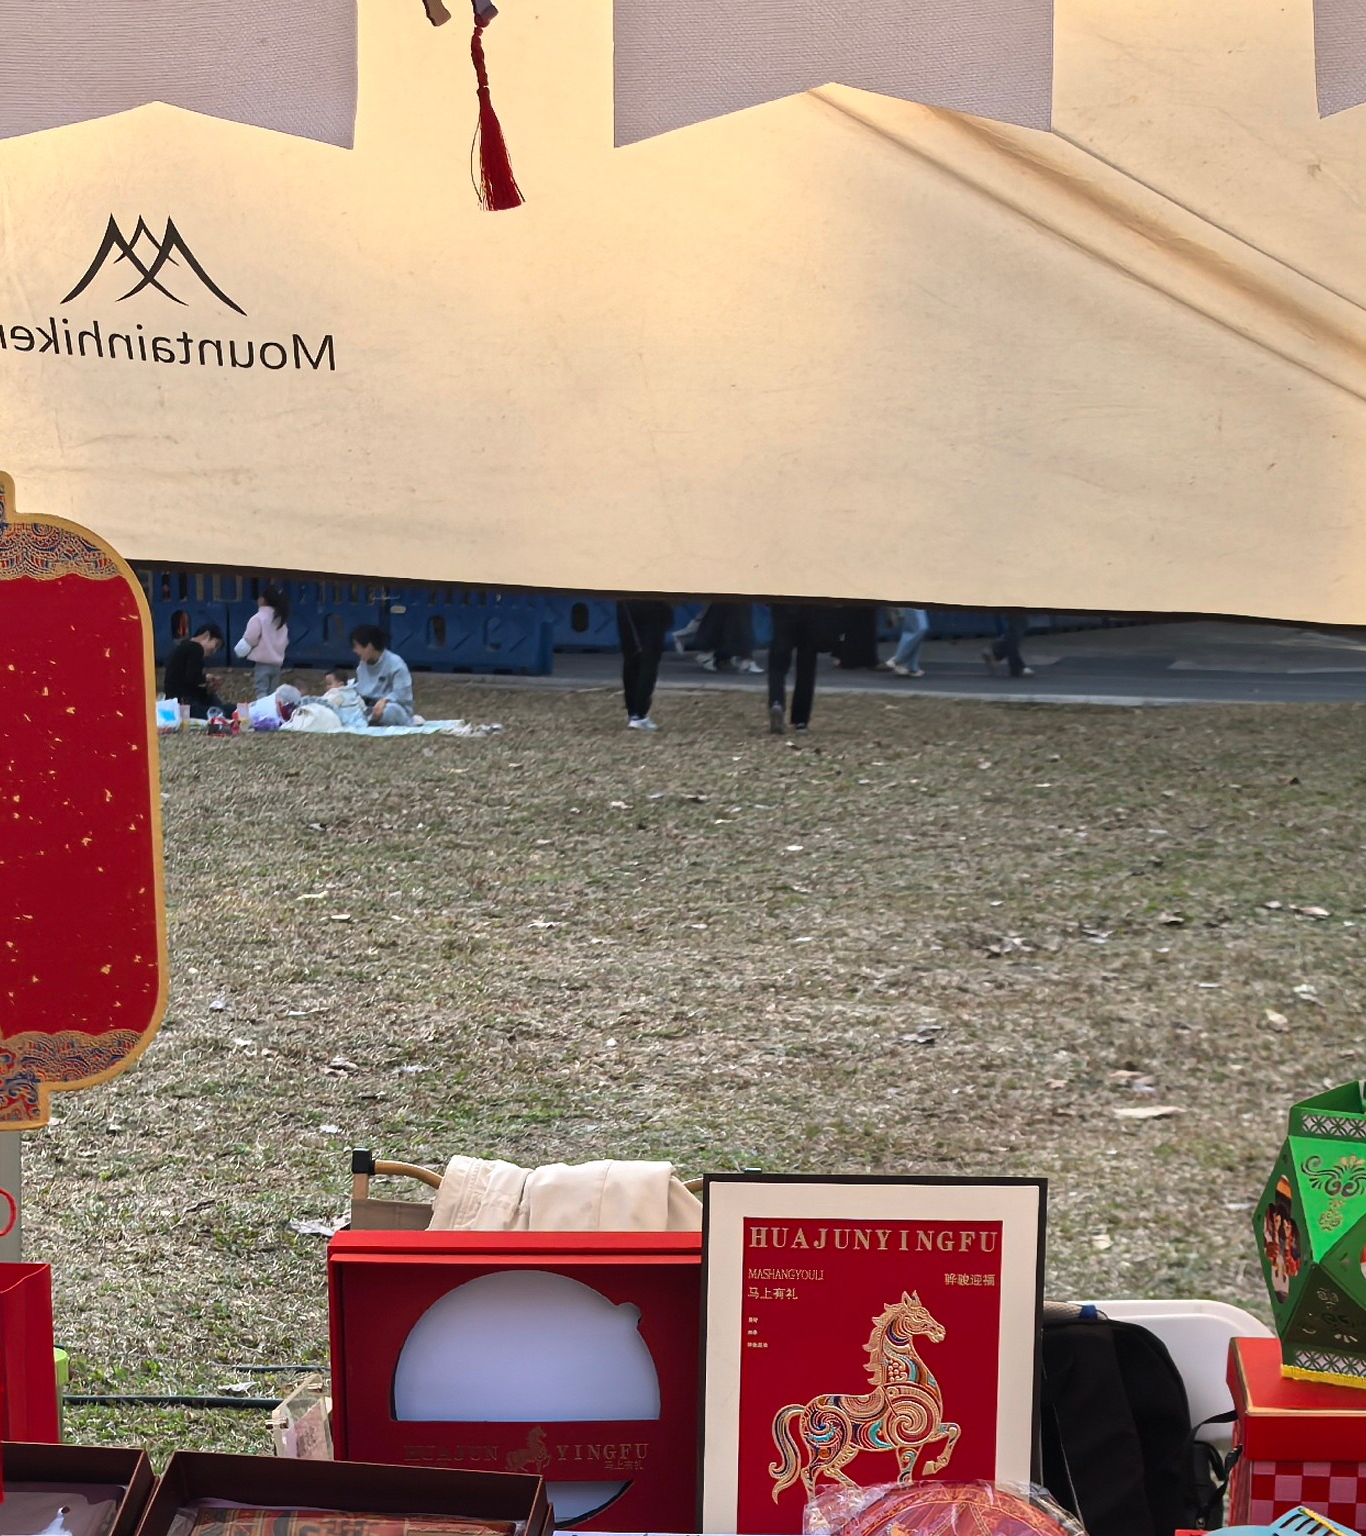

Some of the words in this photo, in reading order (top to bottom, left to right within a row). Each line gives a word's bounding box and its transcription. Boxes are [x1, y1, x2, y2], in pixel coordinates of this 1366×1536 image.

[747, 1286, 799, 1300] 马上有礼
[556, 1443, 650, 1461] YINGFU
